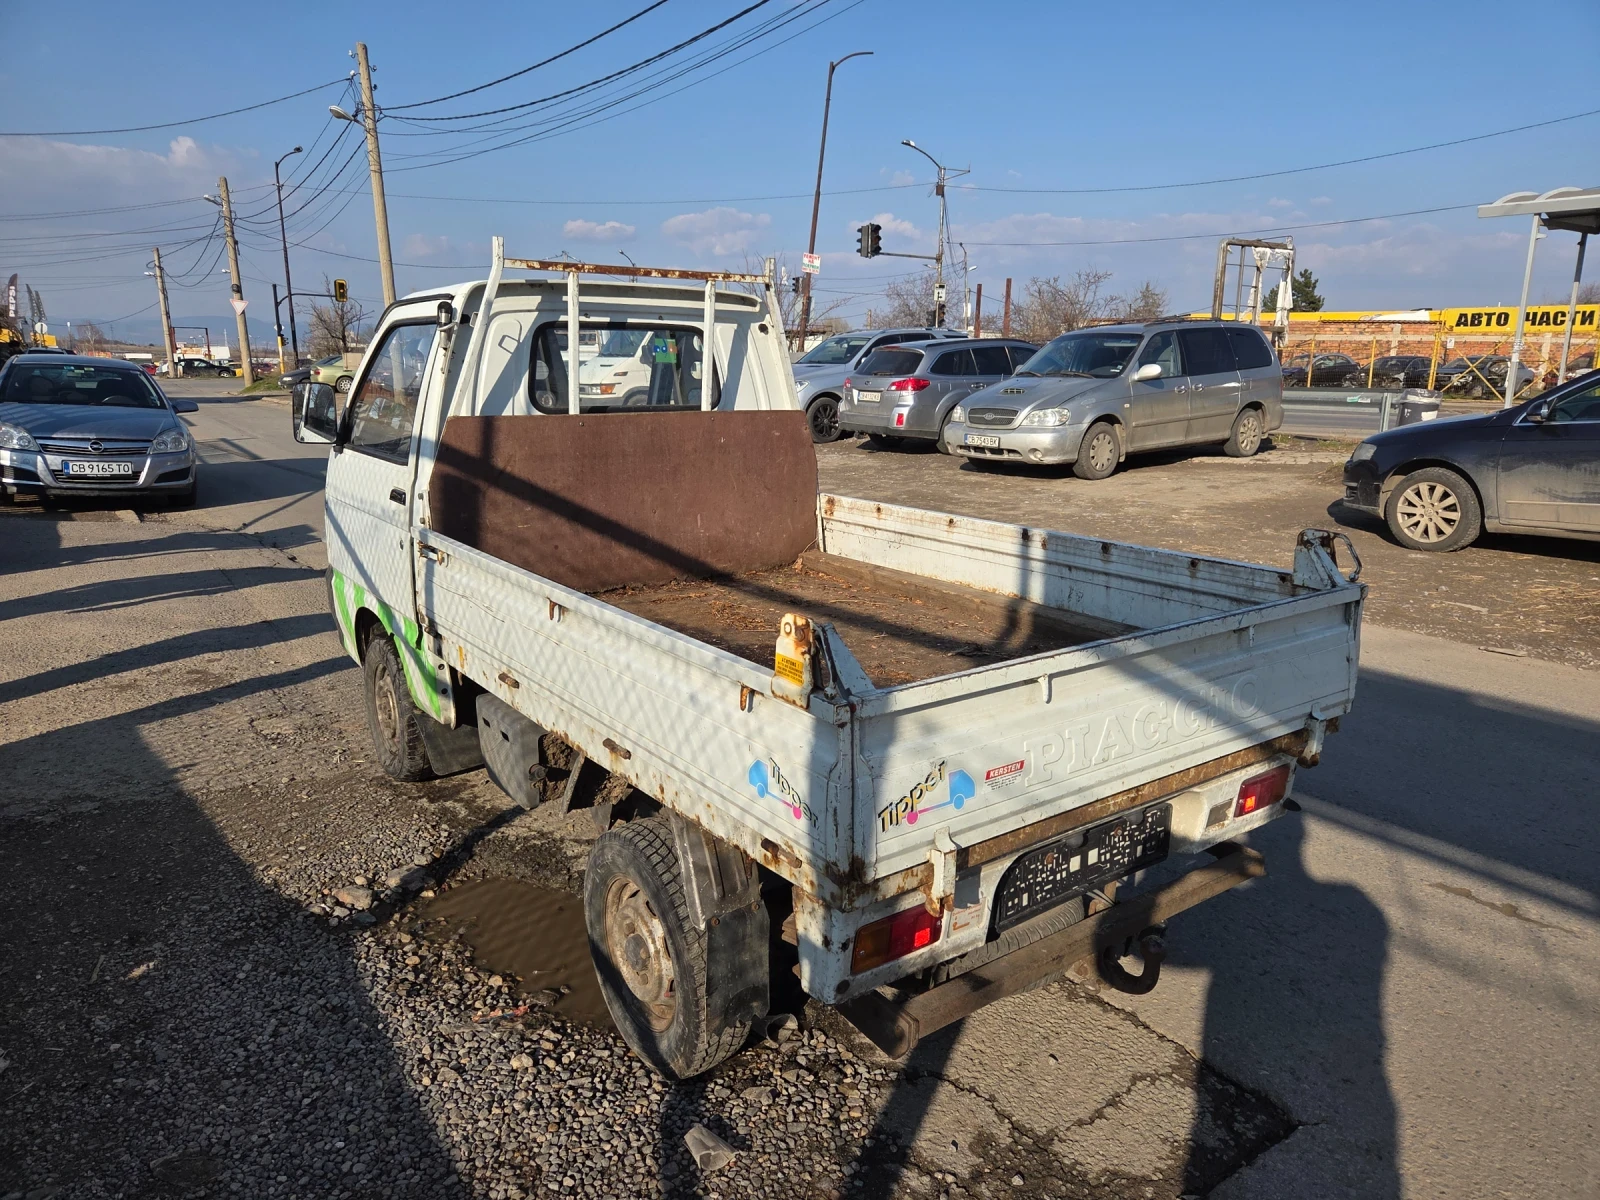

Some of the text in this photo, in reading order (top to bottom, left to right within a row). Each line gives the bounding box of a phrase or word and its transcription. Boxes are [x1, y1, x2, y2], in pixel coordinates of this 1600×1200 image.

[1455, 312, 1510, 327] АВТО
[88, 463, 114, 473] 9165
[1023, 674, 1263, 788] PIAGGIO
[989, 762, 1022, 778] KERSTEN
[769, 757, 820, 829] Tipper
[878, 760, 947, 833] Tipper
